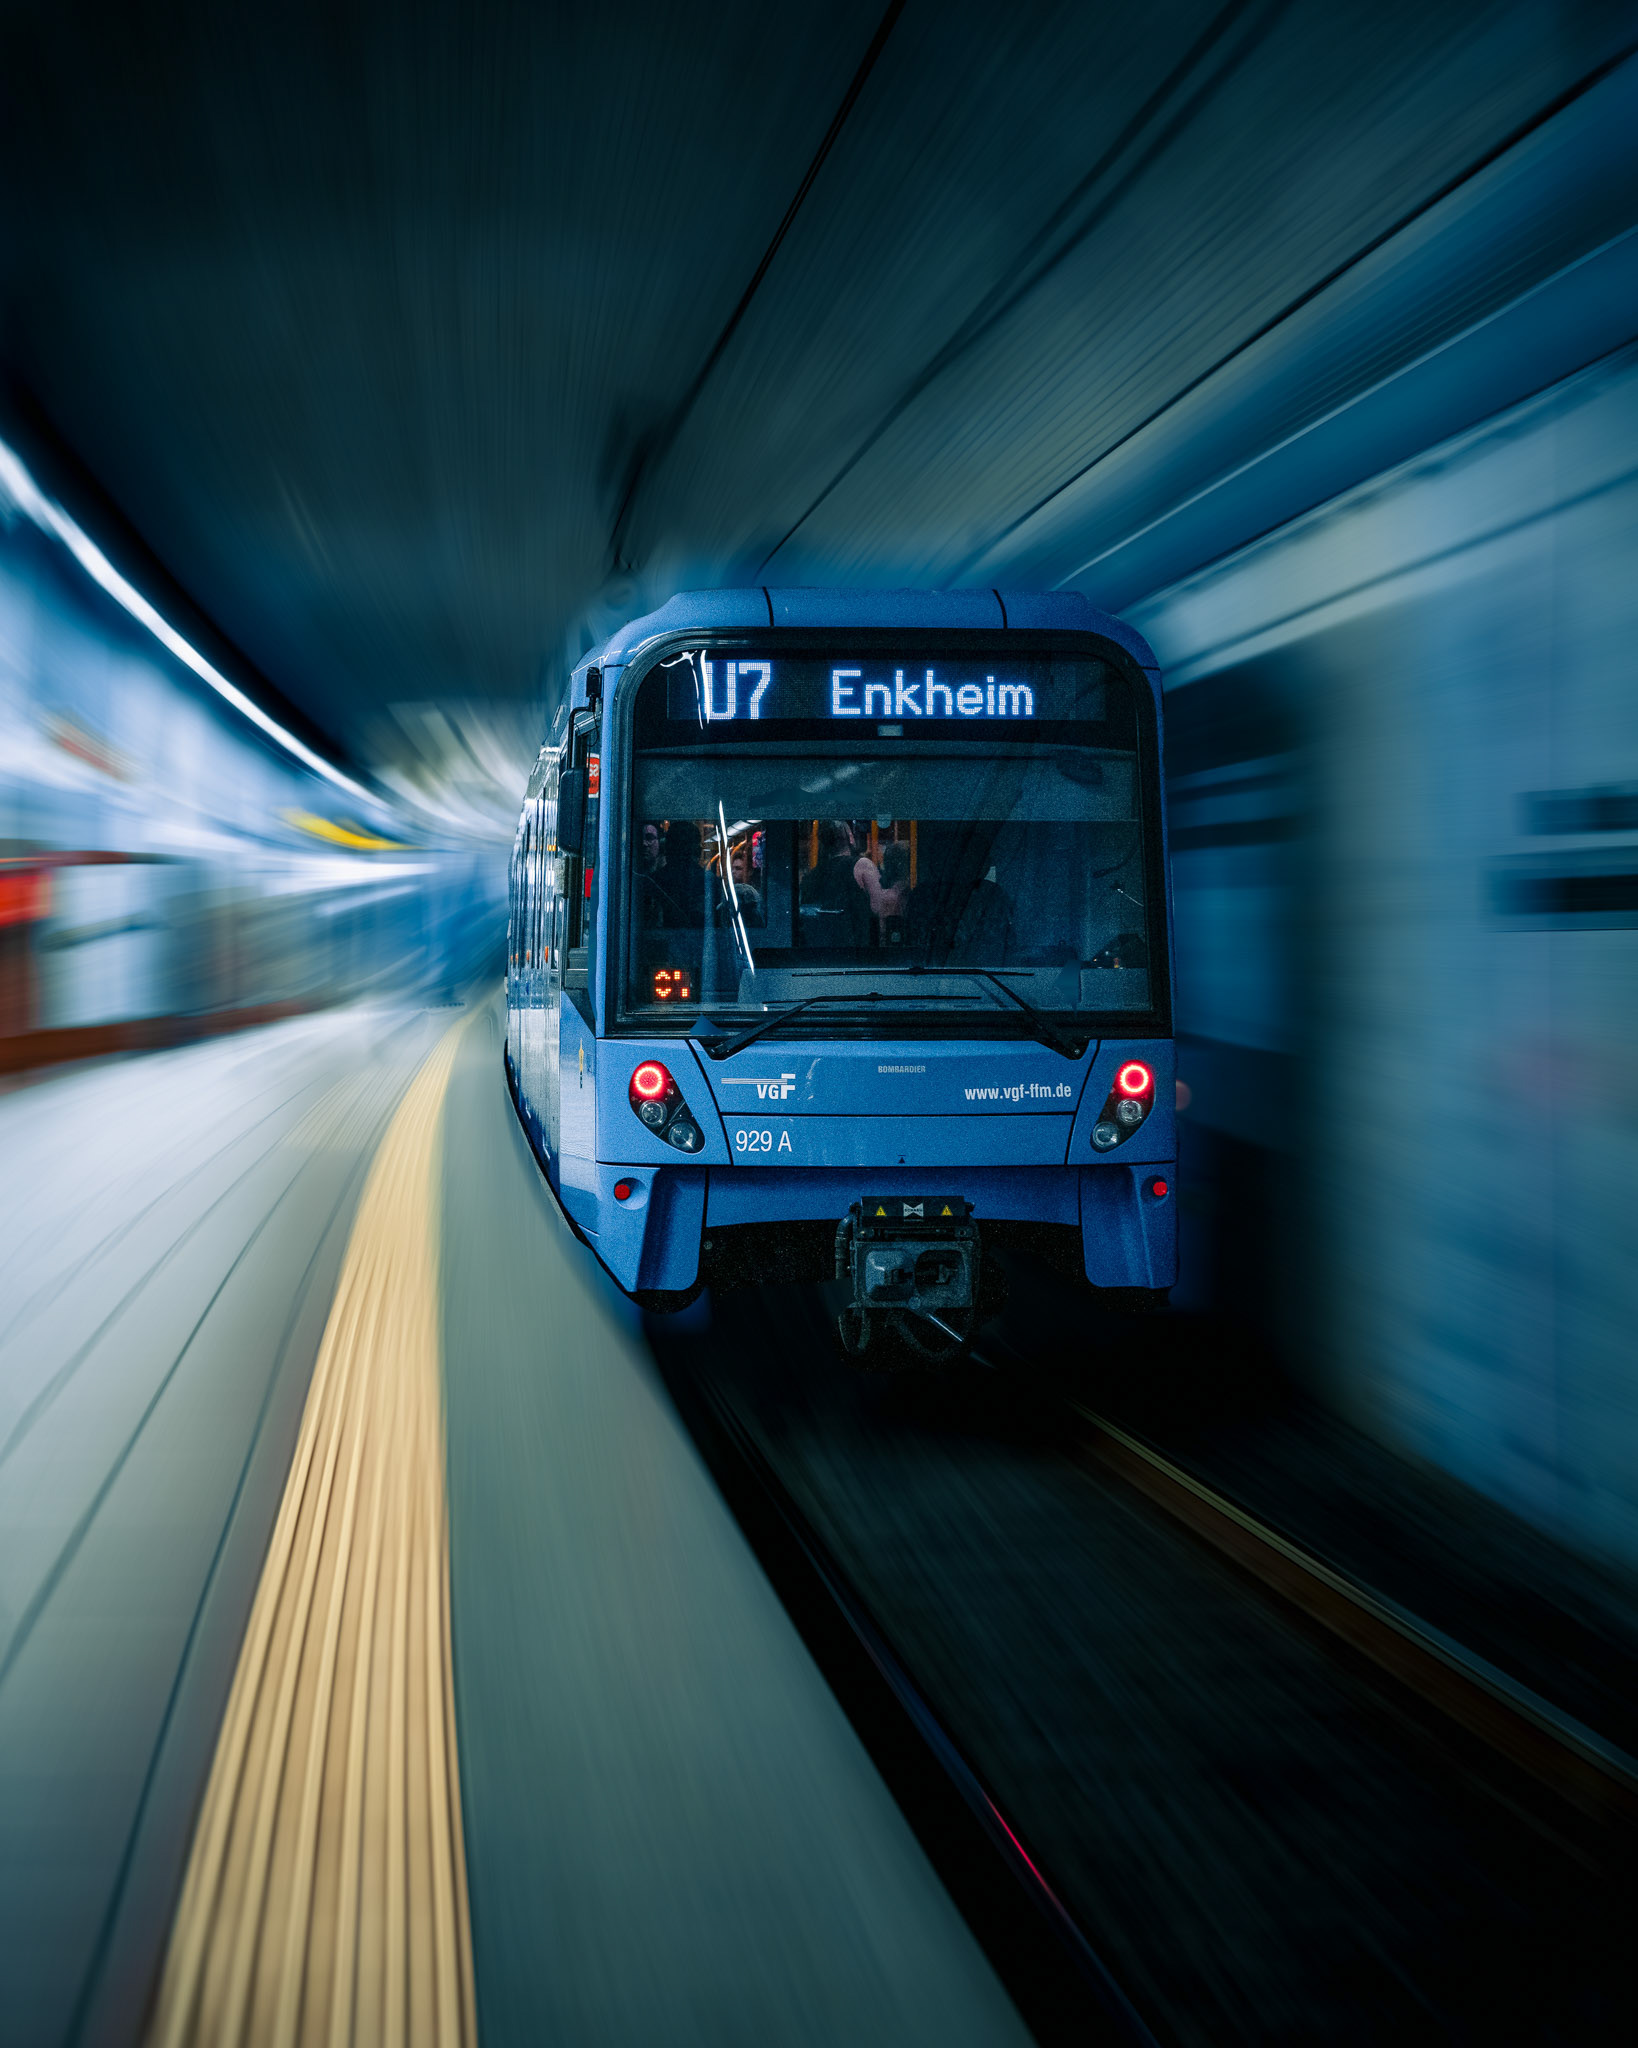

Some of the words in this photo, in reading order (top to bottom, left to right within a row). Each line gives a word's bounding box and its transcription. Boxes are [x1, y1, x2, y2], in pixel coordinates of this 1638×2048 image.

[704, 662, 771, 720] U7
[832, 670, 1033, 715] Enkheim
[878, 1065, 926, 1073] BOMBARDIER
[757, 1073, 796, 1099] VGF
[964, 1083, 1072, 1101] www.vgf-ffm.de
[735, 1130, 773, 1152] 929
[777, 1130, 793, 1152] A
